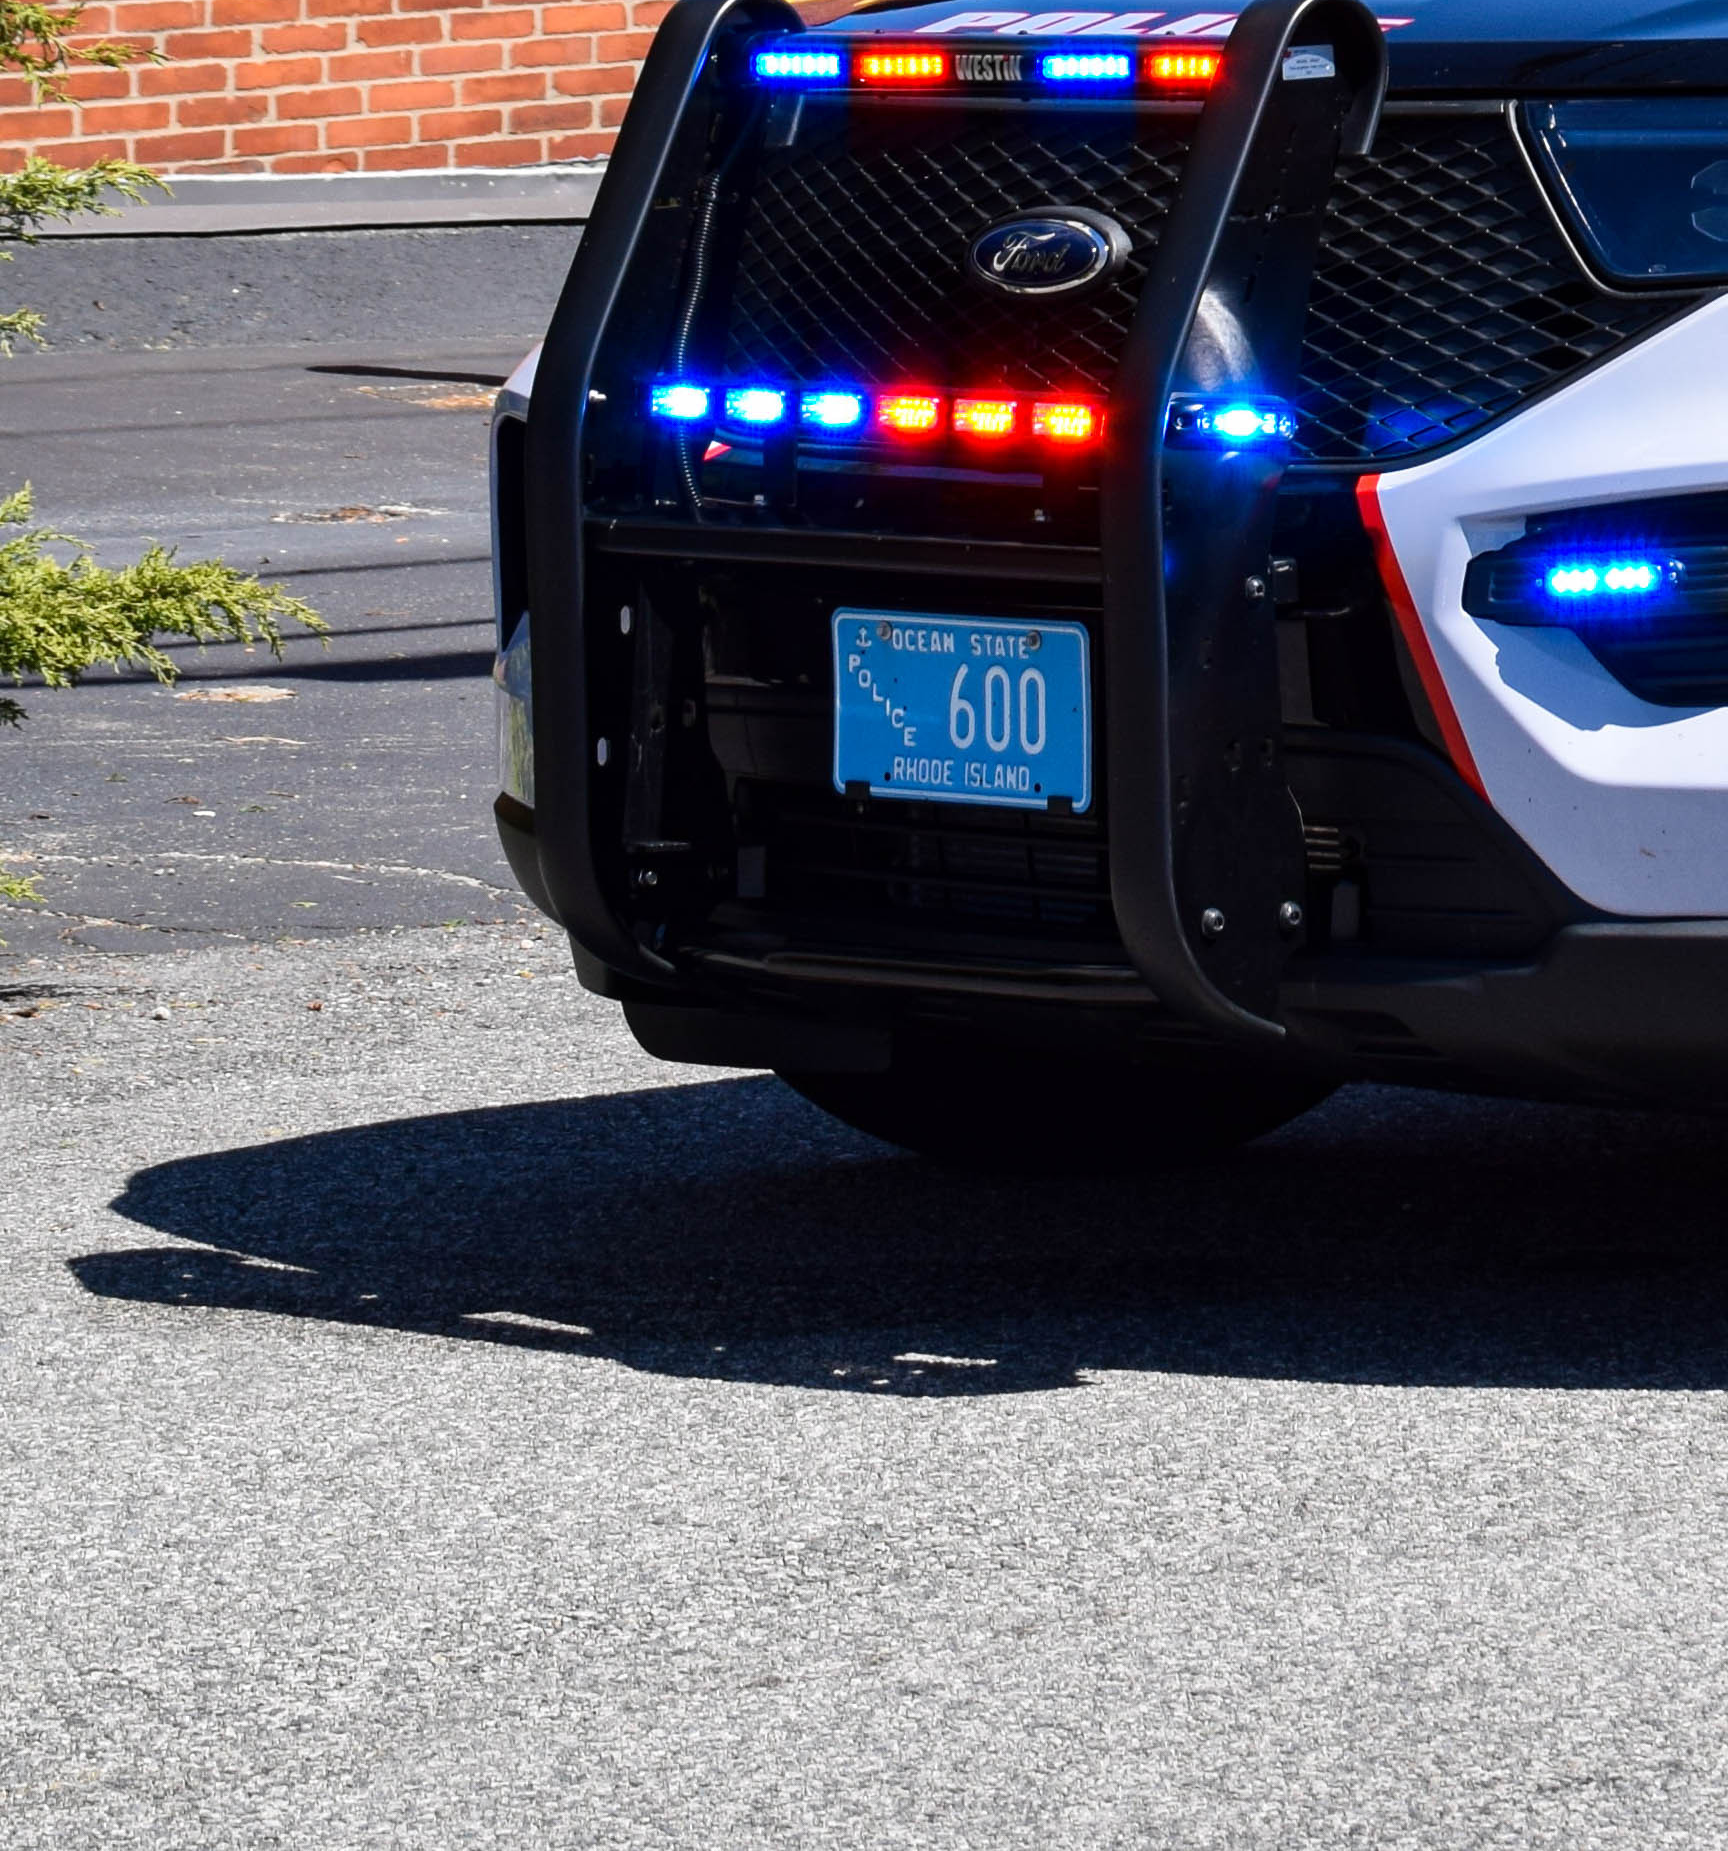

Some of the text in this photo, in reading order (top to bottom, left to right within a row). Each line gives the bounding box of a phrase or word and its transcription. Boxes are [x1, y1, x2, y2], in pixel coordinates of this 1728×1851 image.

[993, 231, 1071, 272] Ford
[891, 628, 1030, 659] OCEAN STATE
[949, 663, 1046, 755] 600
[893, 757, 1030, 792] RHODE ISLAND
